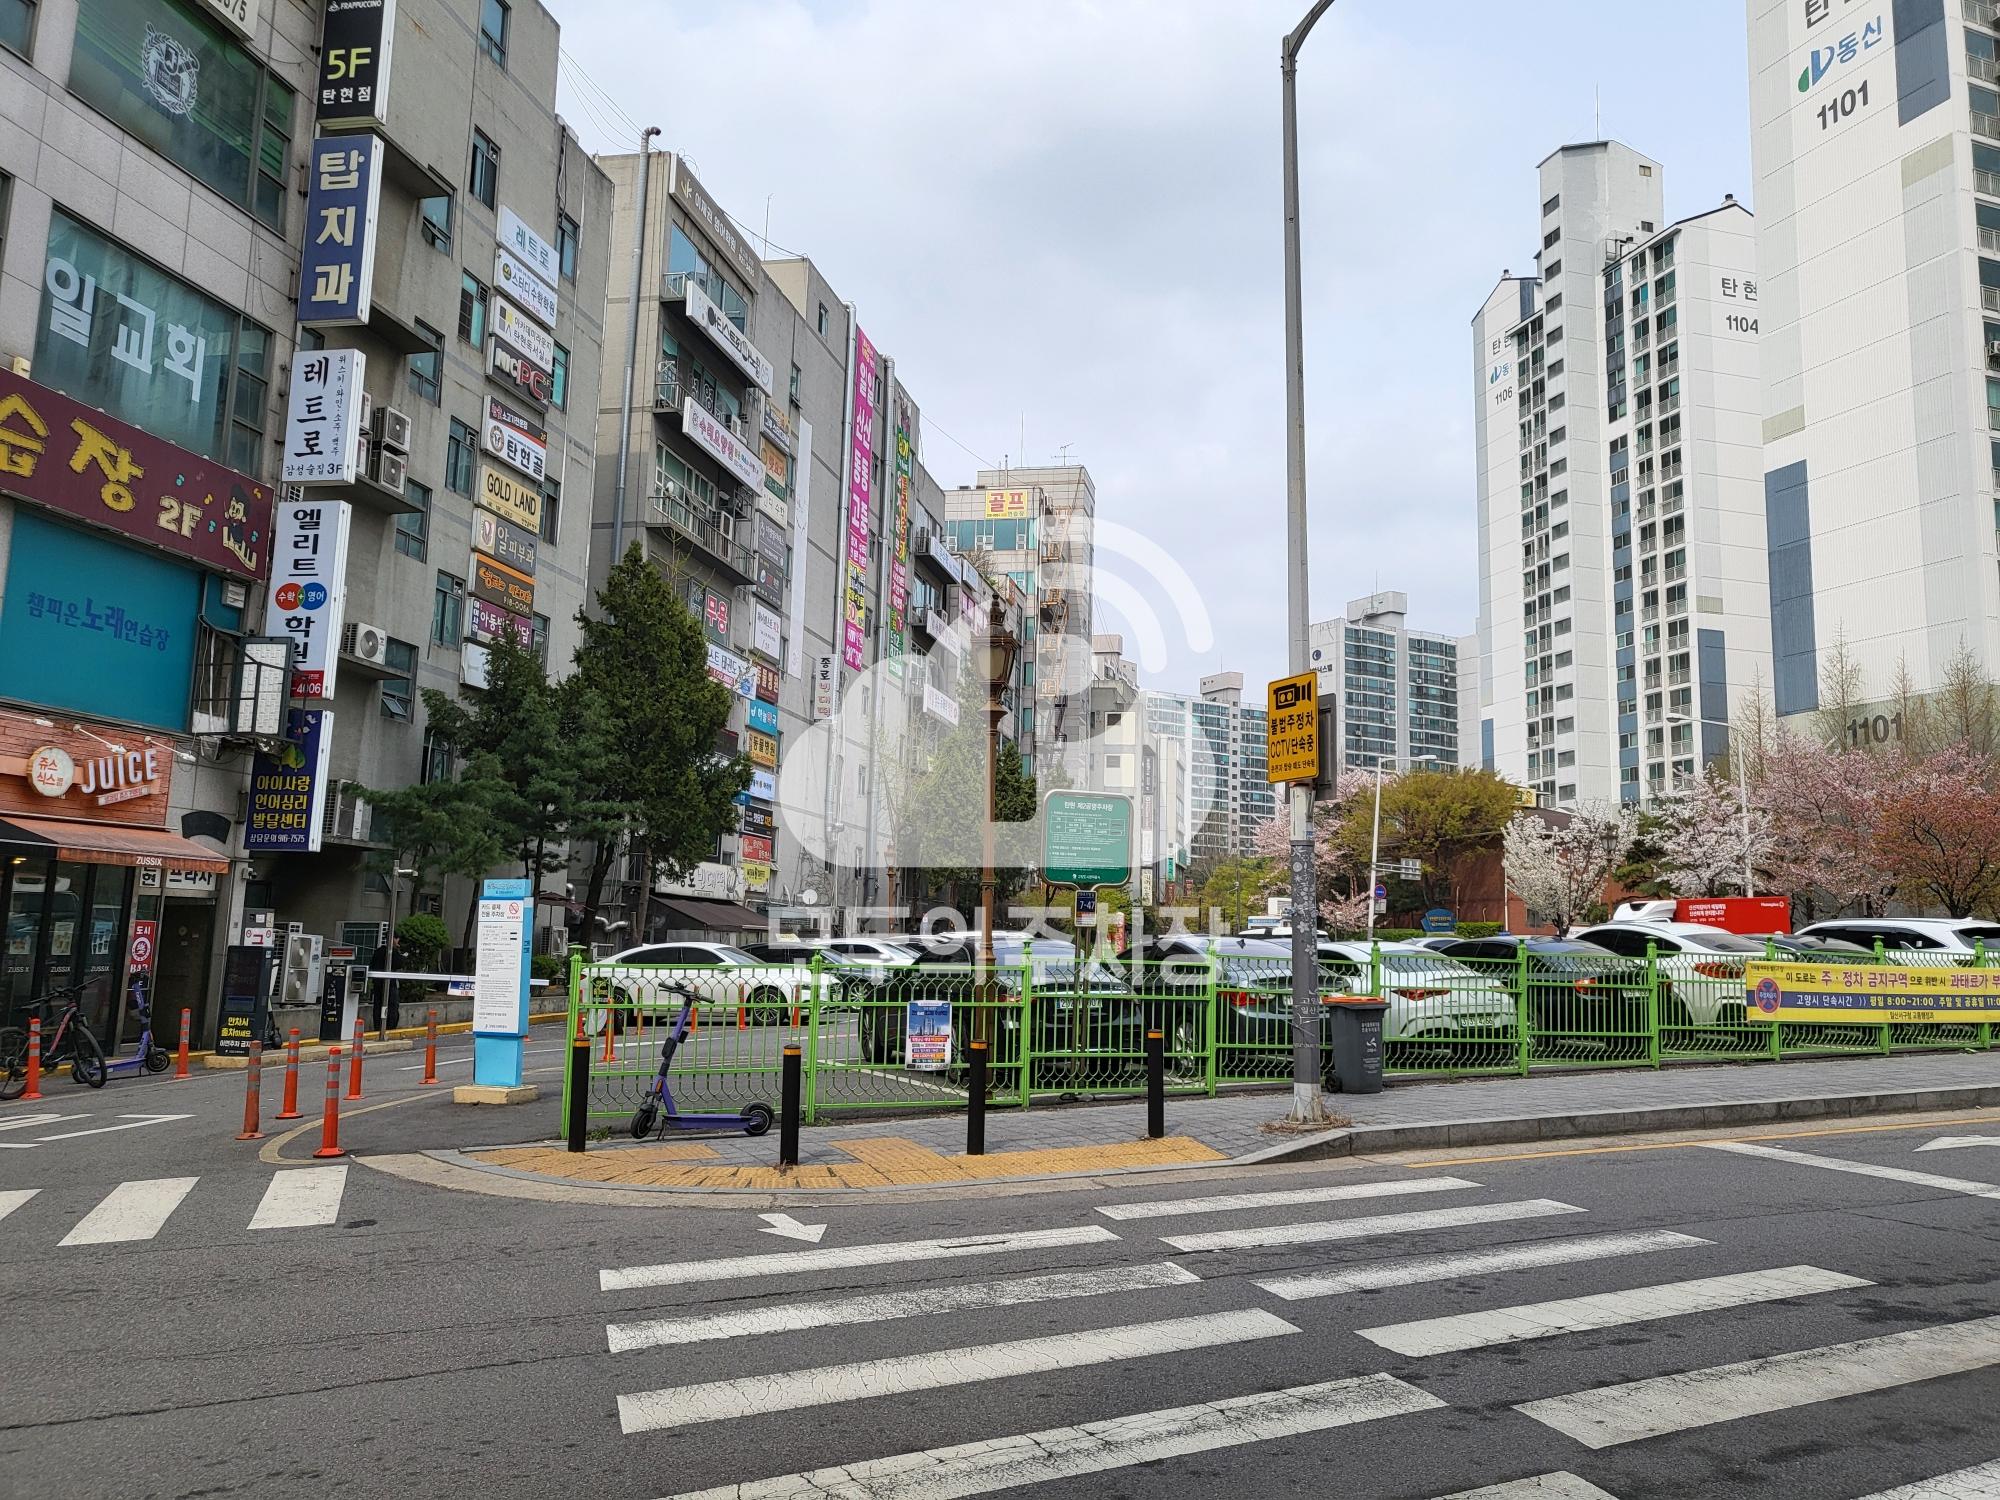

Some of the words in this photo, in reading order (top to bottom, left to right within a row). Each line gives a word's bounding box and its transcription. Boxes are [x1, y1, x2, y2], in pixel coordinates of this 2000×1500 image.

[1837, 15, 1882, 64] 동신
[327, 48, 372, 80] 5F
[323, 86, 371, 105] 탄현점
[1817, 79, 1869, 130] 1101
[311, 150, 365, 306] 탑치과
[515, 225, 550, 271] 레트로
[1725, 314, 1758, 335] 1104
[293, 356, 330, 458] 레트로
[1495, 386, 1513, 405] 1106
[327, 463, 343, 475] 3F
[507, 440, 543, 478] 탄현골
[487, 473, 511, 502] GOLD
[514, 488, 537, 516] LAND
[989, 492, 1024, 512] 골프
[156, 494, 203, 540] 2F
[289, 508, 322, 577] 엘리트
[278, 591, 296, 602] 수학
[307, 590, 324, 602] 영어
[707, 594, 728, 634] 무용
[1270, 709, 1314, 736] 불법주정차
[1846, 712, 1903, 746] 1101
[1270, 734, 1314, 759] CCTV단속중
[39, 757, 58, 771] 쥬스
[81, 748, 160, 794] JUICE
[256, 775, 311, 792] 아이사랑
[255, 793, 307, 811] 언어심리
[252, 812, 307, 829] 발달센터
[250, 833, 277, 843] 상담문의
[136, 857, 162, 867] ZUSSIX
[1785, 972, 1793, 983] 이
[1795, 972, 1817, 984] 도로는
[1950, 973, 1989, 989] 과태료가
[1796, 994, 1819, 1006] 고양시
[1822, 994, 1853, 1007] 단속시간
[1870, 996, 1884, 1007] 평일
[1964, 997, 1985, 1008] 공휴일
